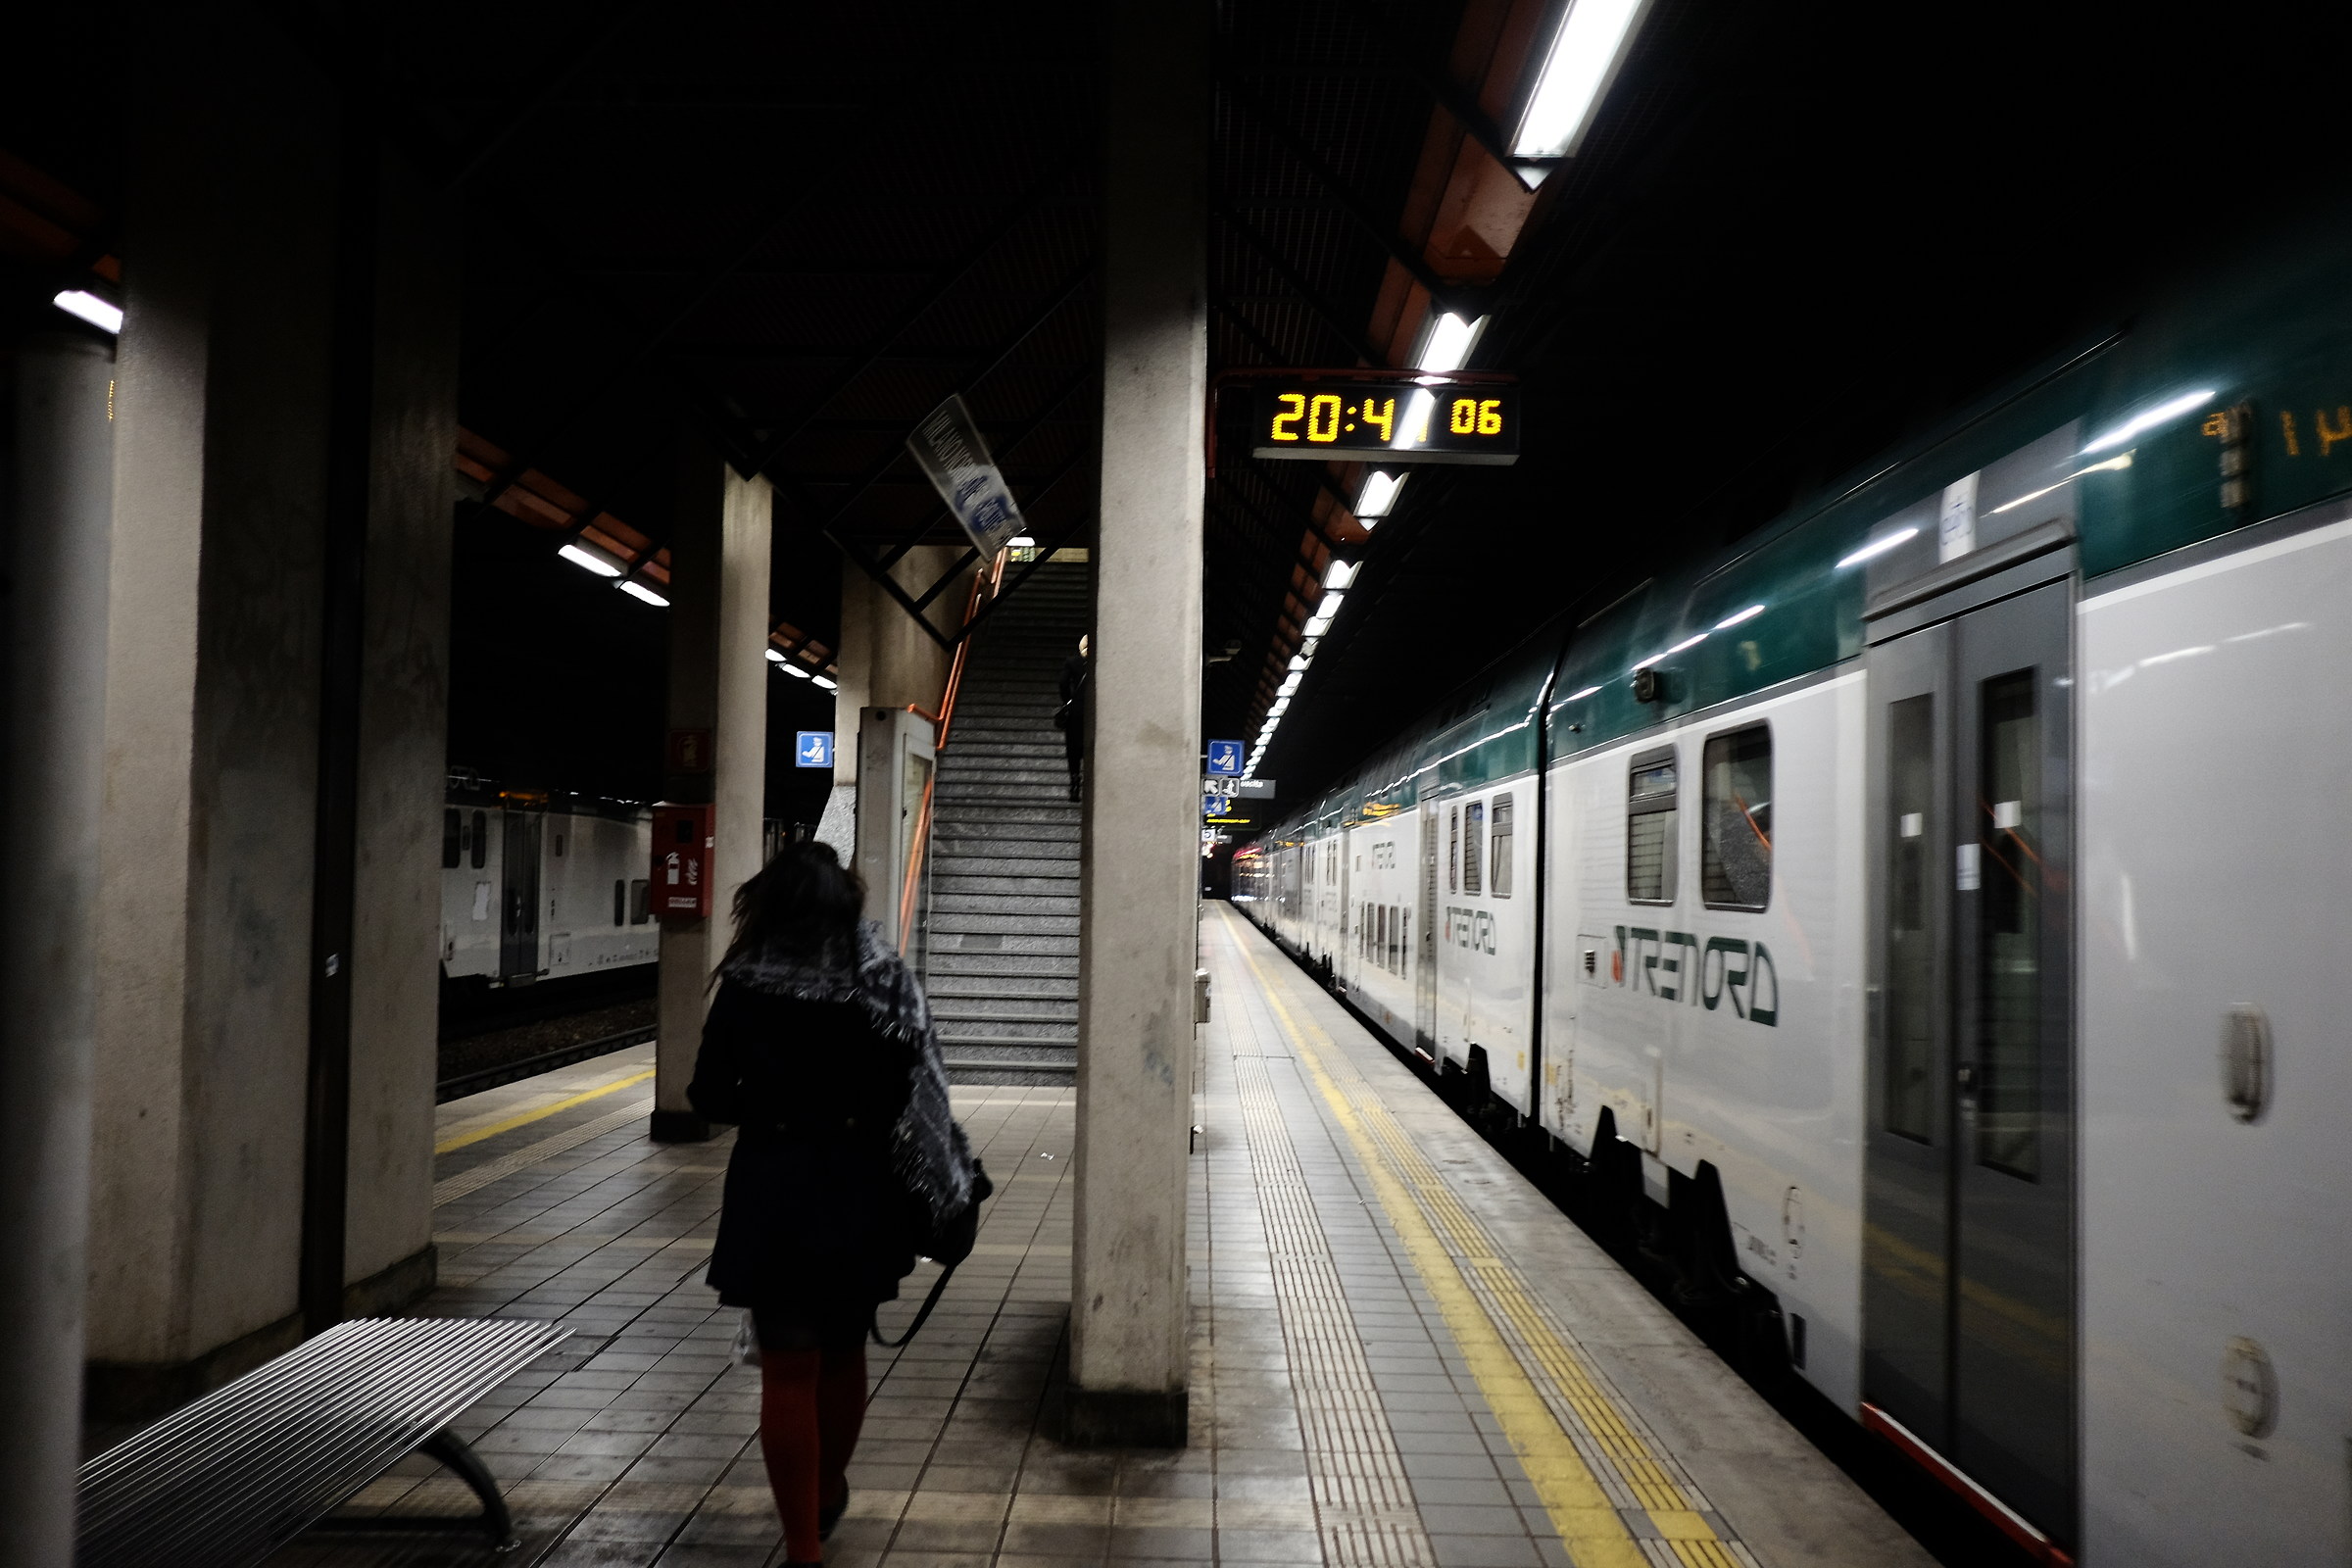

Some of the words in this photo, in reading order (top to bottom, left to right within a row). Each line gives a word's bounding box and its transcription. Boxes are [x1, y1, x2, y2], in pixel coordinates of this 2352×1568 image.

[921, 409, 964, 463] MILANO
[1449, 398, 1502, 435] 06
[1630, 925, 1779, 1027] TRENORD
